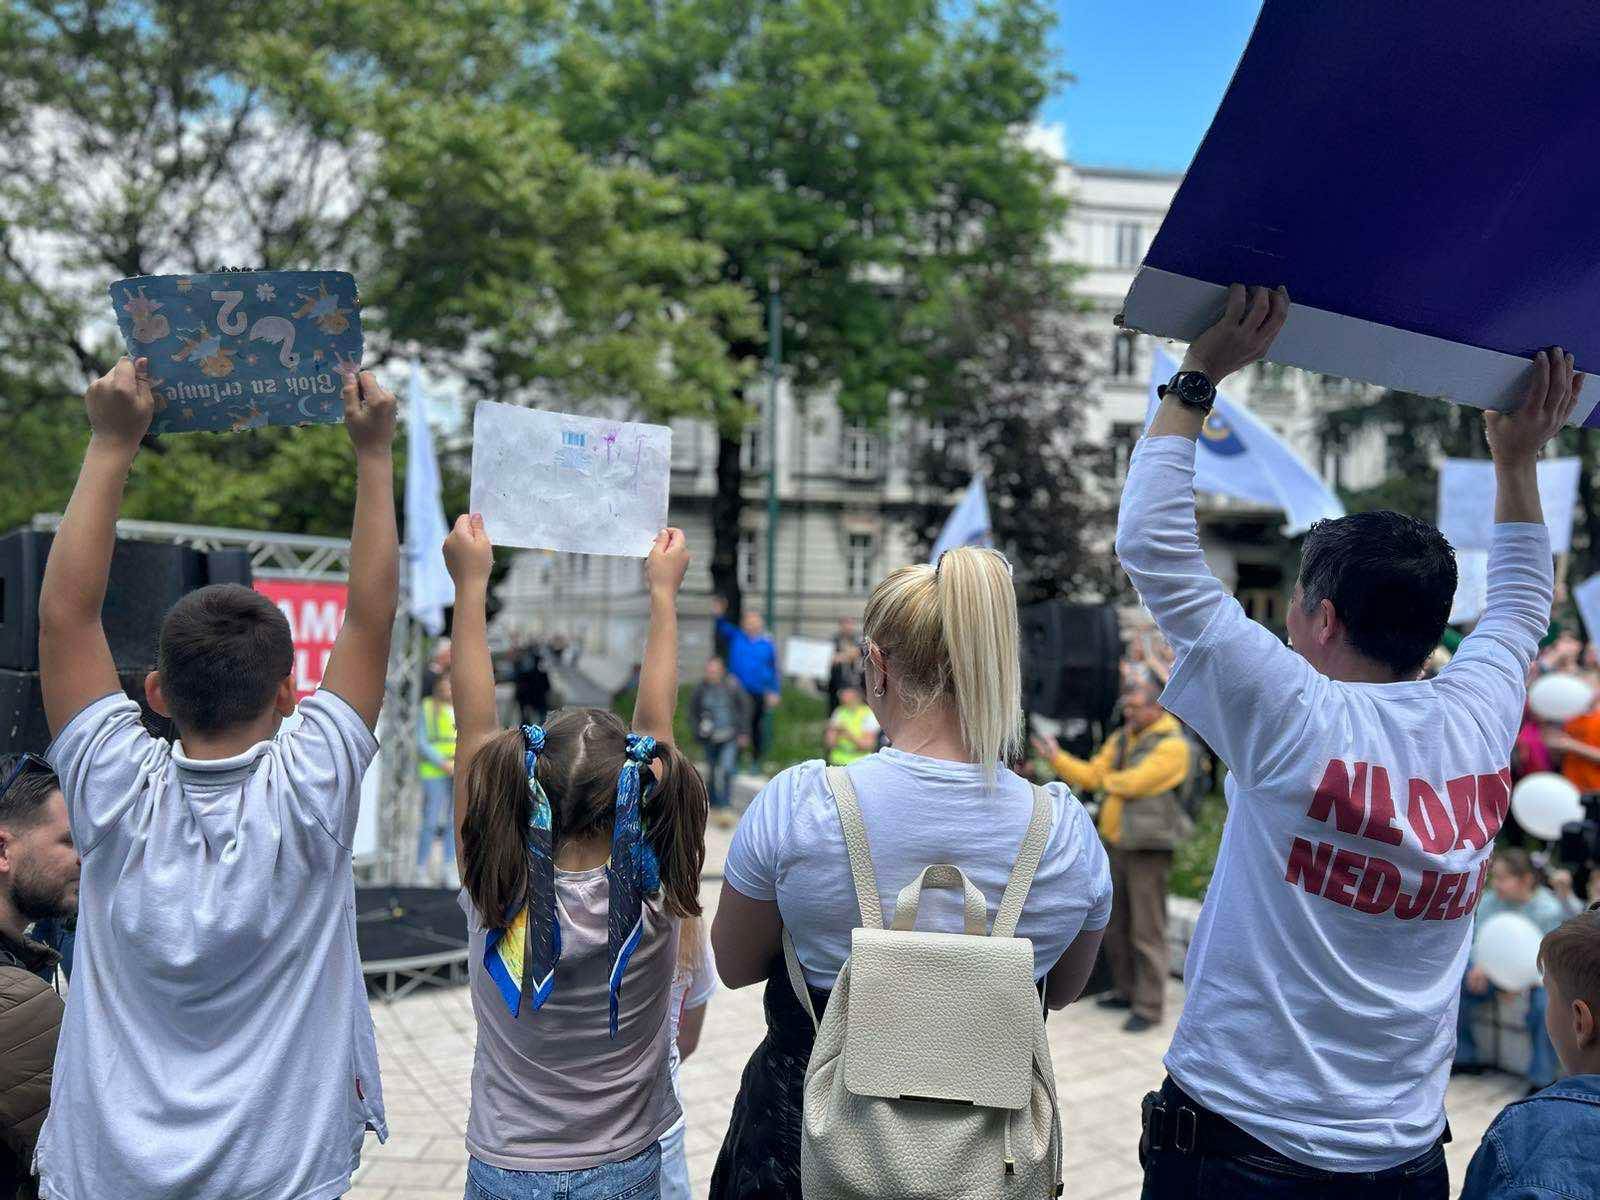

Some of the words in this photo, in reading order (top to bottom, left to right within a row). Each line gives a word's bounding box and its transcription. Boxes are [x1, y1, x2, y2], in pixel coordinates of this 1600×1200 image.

[211, 290, 247, 335] 2
[167, 381, 243, 404] crtanje
[251, 378, 278, 394] za
[286, 374, 336, 395] Blok
[277, 600, 346, 643] AM
[1285, 837, 1488, 921] NEDJELJ
